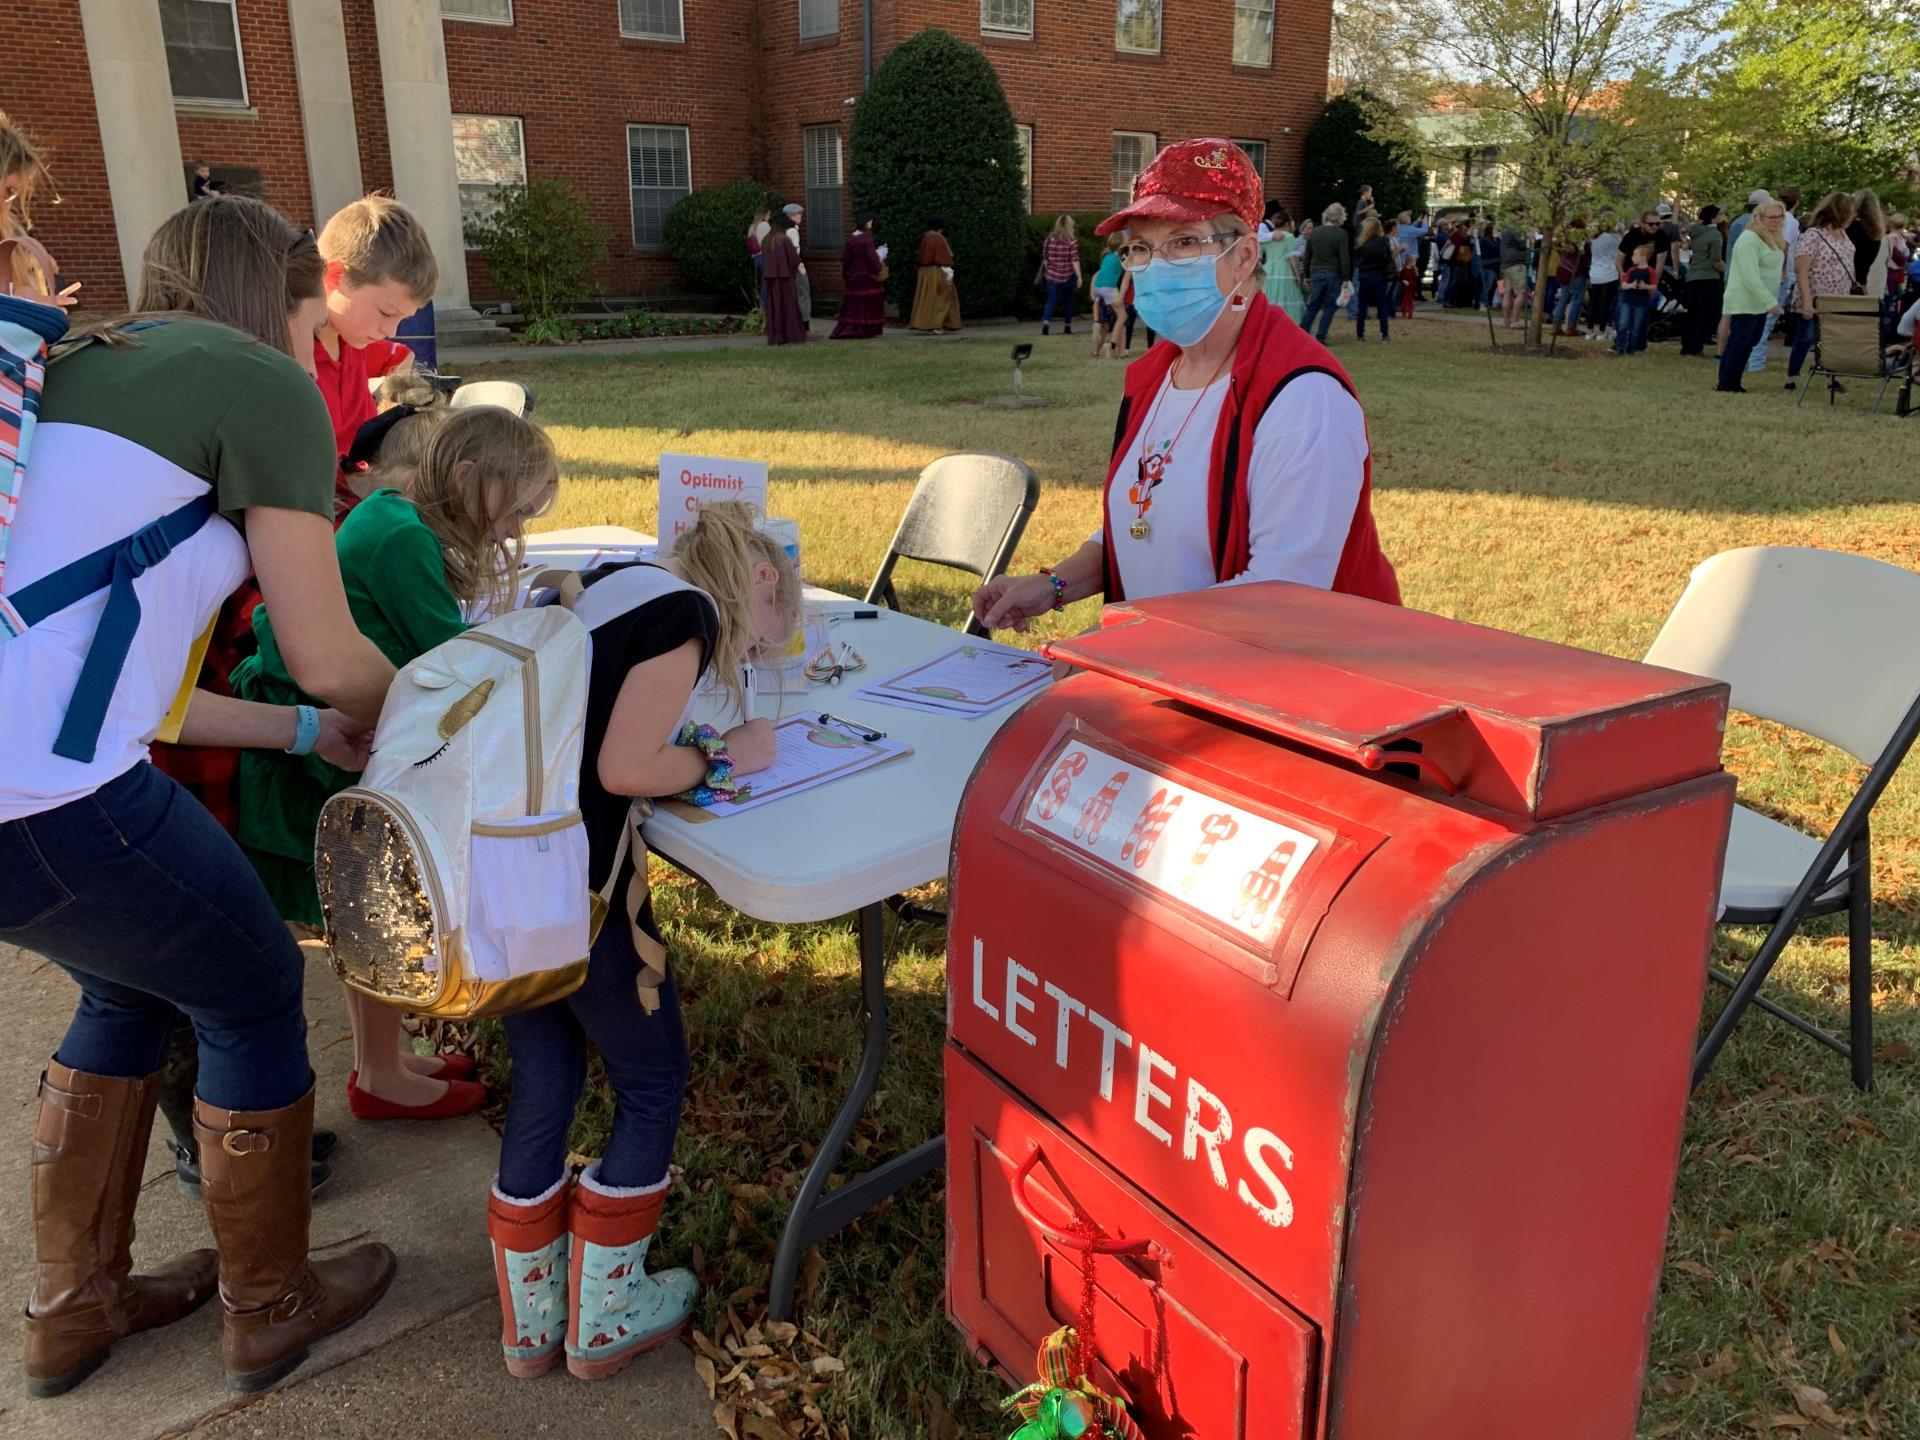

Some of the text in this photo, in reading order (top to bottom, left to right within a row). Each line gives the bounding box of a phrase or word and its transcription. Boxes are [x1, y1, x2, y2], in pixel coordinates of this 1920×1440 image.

[680, 469, 744, 491] Optimist
[1036, 751, 1298, 929] SANTA
[973, 935, 1294, 1228] LETTERS
